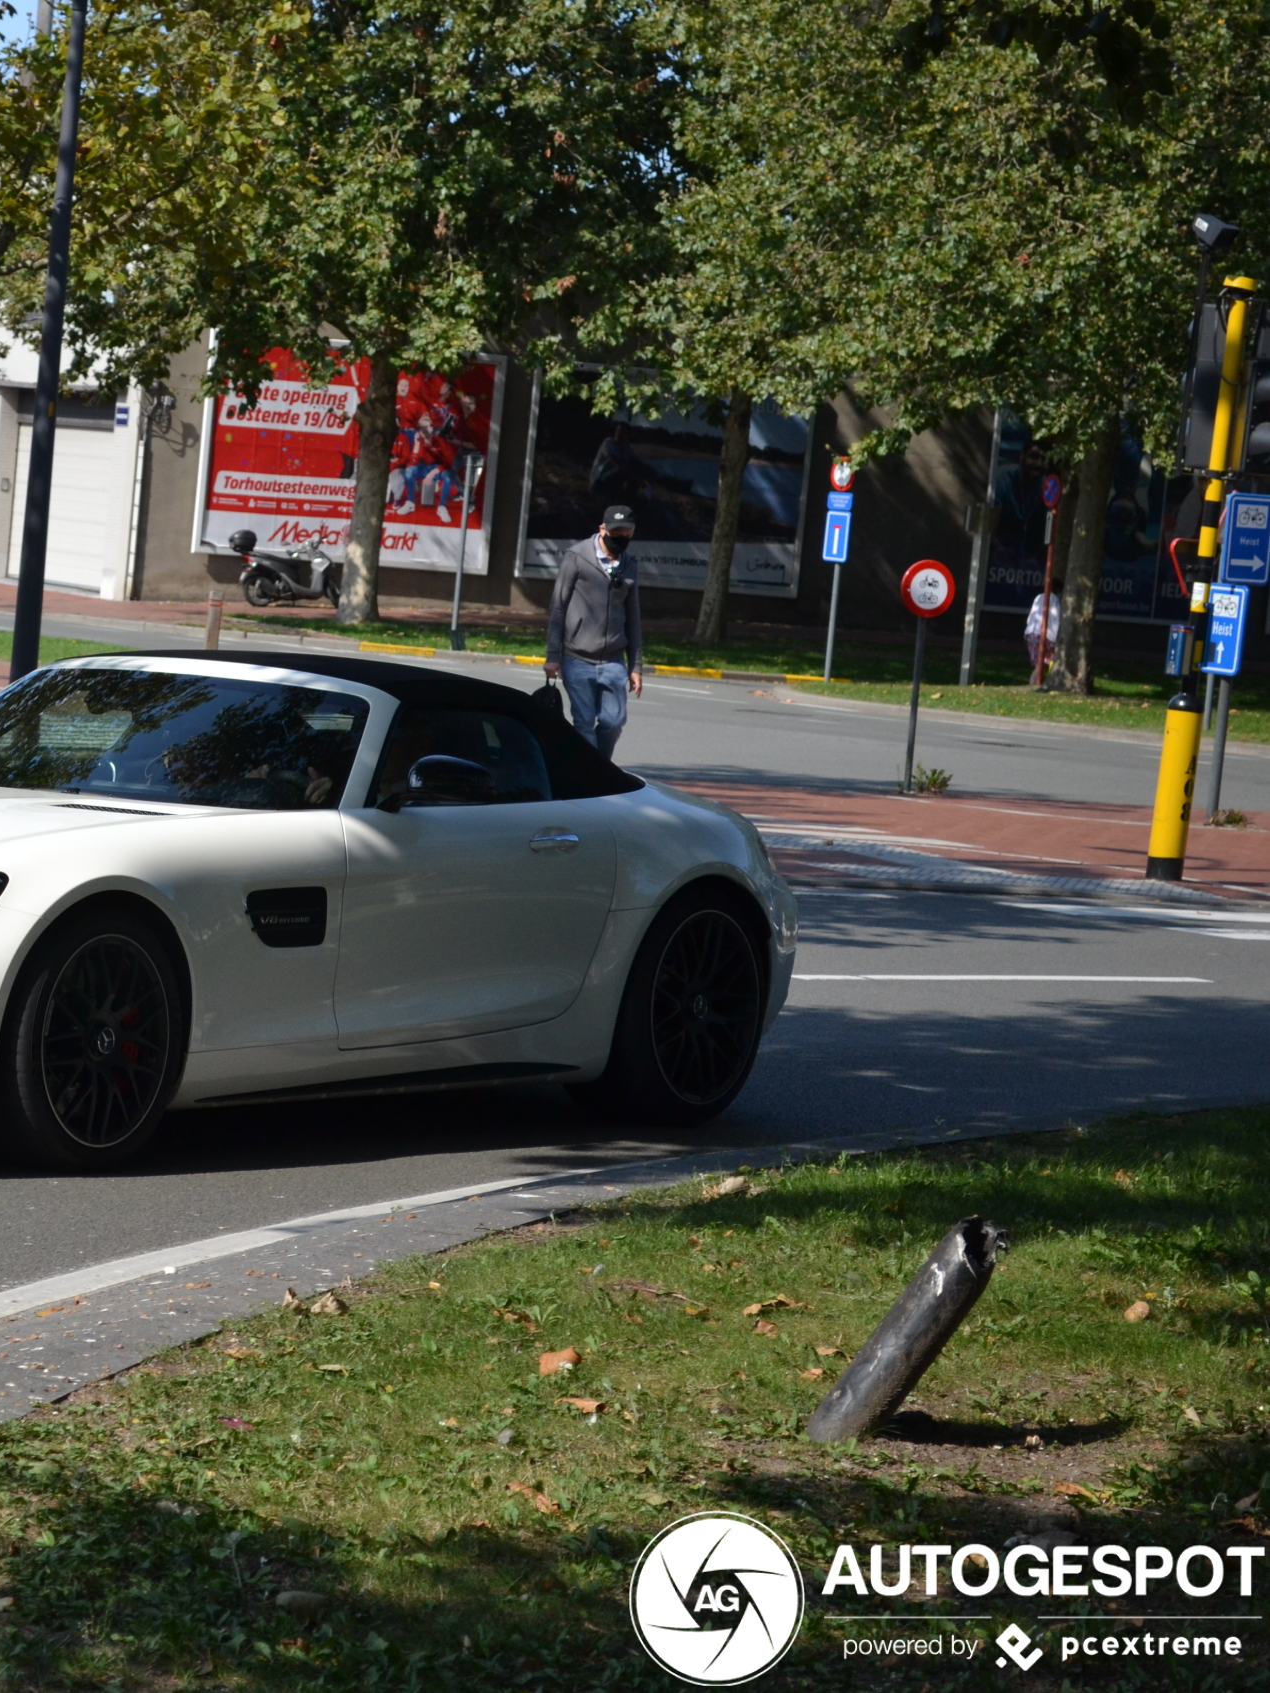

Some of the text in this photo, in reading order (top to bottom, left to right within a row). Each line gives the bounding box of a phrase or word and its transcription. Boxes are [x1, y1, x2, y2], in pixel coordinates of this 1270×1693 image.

[282, 389, 349, 411] opening
[224, 475, 356, 500] Torhoutsesteenweg
[1239, 536, 1260, 546] Heist
[653, 555, 708, 568] VISITLIMBUR
[988, 566, 1044, 587] SPORTO
[1211, 620, 1233, 637] Heist
